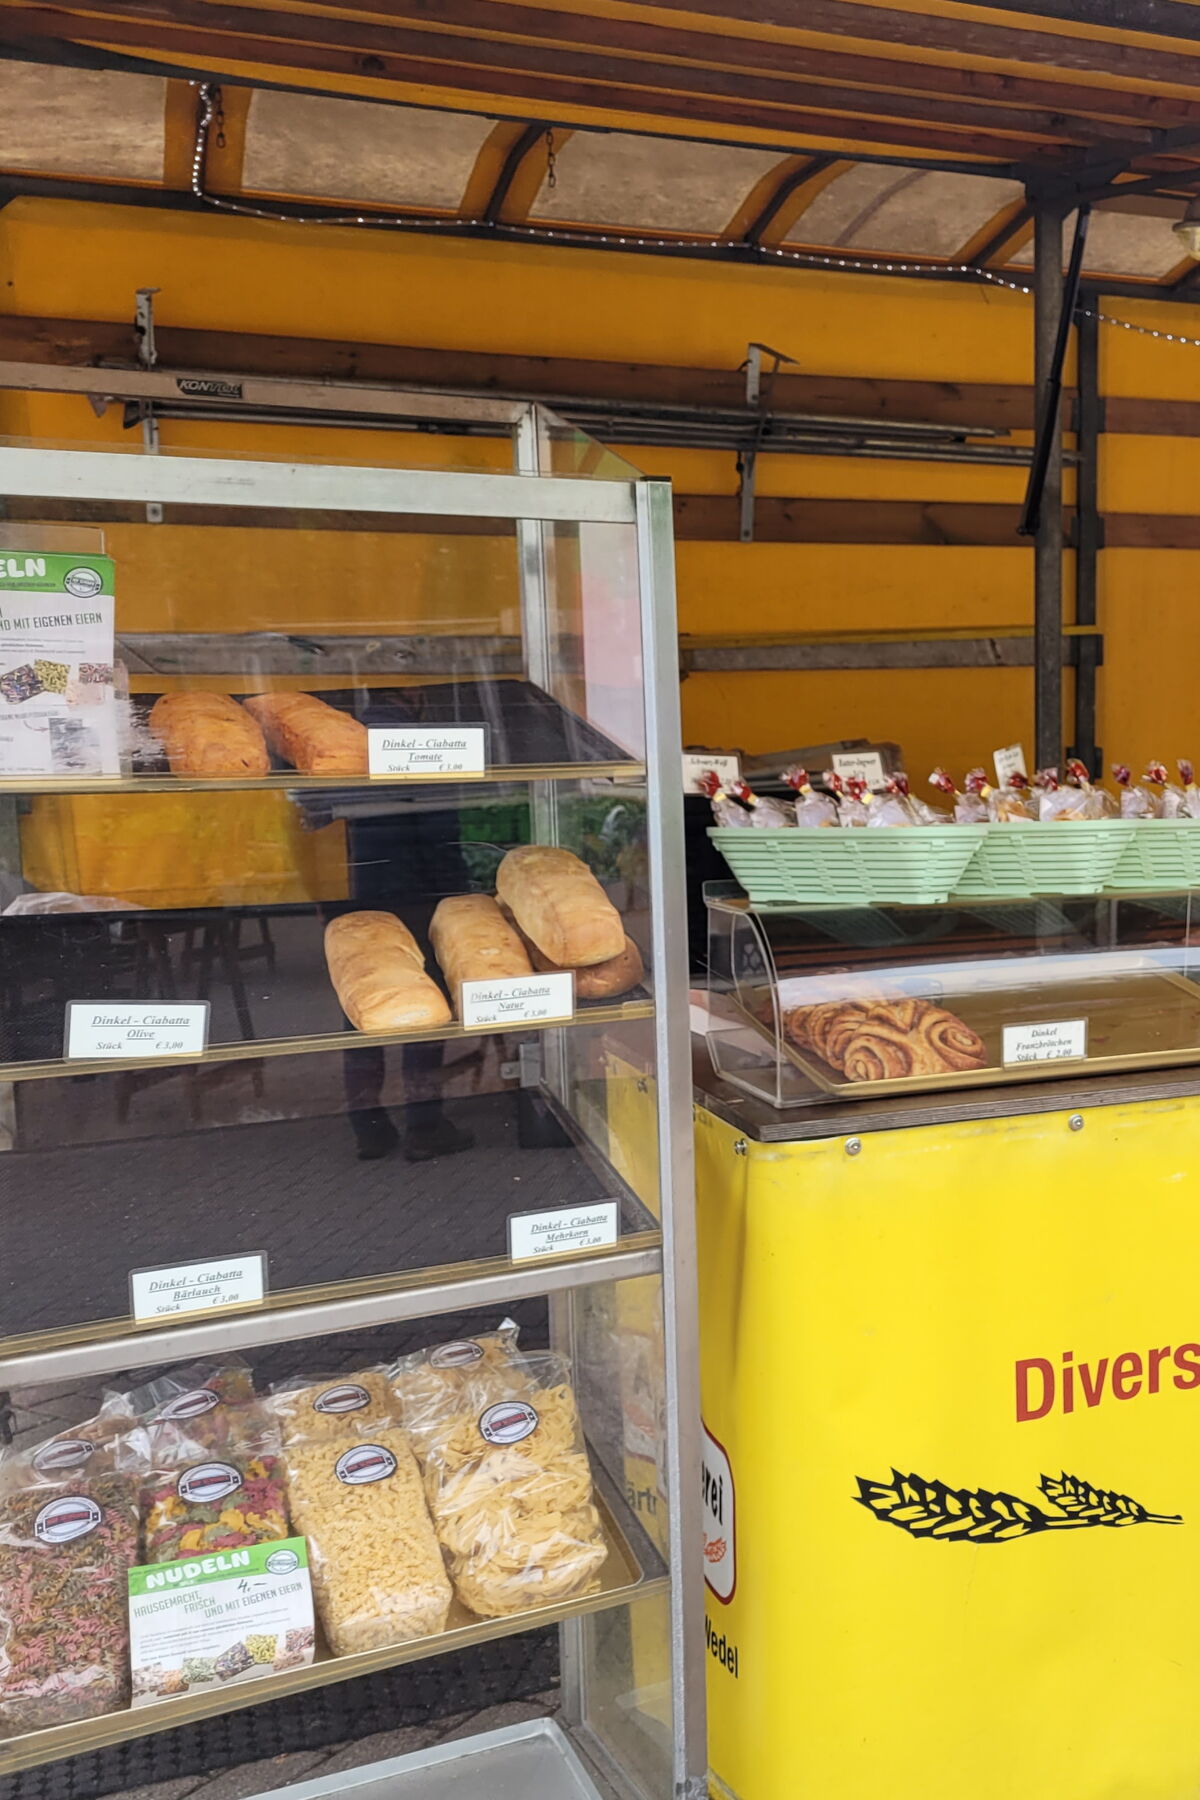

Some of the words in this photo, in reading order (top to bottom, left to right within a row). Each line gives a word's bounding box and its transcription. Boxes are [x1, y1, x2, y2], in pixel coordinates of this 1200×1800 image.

[14, 617, 31, 630] MIT
[33, 614, 73, 628] EIGENEN
[75, 612, 103, 625] EIERN
[382, 739, 416, 748] Dinkel
[425, 739, 467, 748] Ciabatta
[408, 752, 443, 761] Tomate
[471, 990, 503, 1001] Dinkel
[512, 986, 551, 998] Ciabatta
[499, 1001, 525, 1010] Natur
[92, 1016, 132, 1025] Dinkel
[142, 1015, 190, 1025] Ciabatta
[127, 1029, 155, 1038] Olive
[1031, 1027, 1057, 1038] Dinkel
[96, 1041, 122, 1050] Stück
[164, 1041, 184, 1050] 3,00
[531, 1221, 562, 1233] Dinkel
[570, 1215, 608, 1227] Ciabatta
[546, 1230, 589, 1241] Mehrkorn
[149, 1277, 187, 1291] Dinkel
[197, 1270, 243, 1283] Ciabatta
[173, 1285, 221, 1299] Bärlauch
[155, 1304, 181, 1313] Stück
[702, 1460, 723, 1526] rei
[146, 1550, 250, 1589] NUDELN
[204, 1606, 224, 1618] UND
[225, 1599, 241, 1612] MIT
[242, 1590, 278, 1607] EIGENEN
[279, 1581, 304, 1596] EIERN
[184, 1597, 216, 1615] FRISCH
